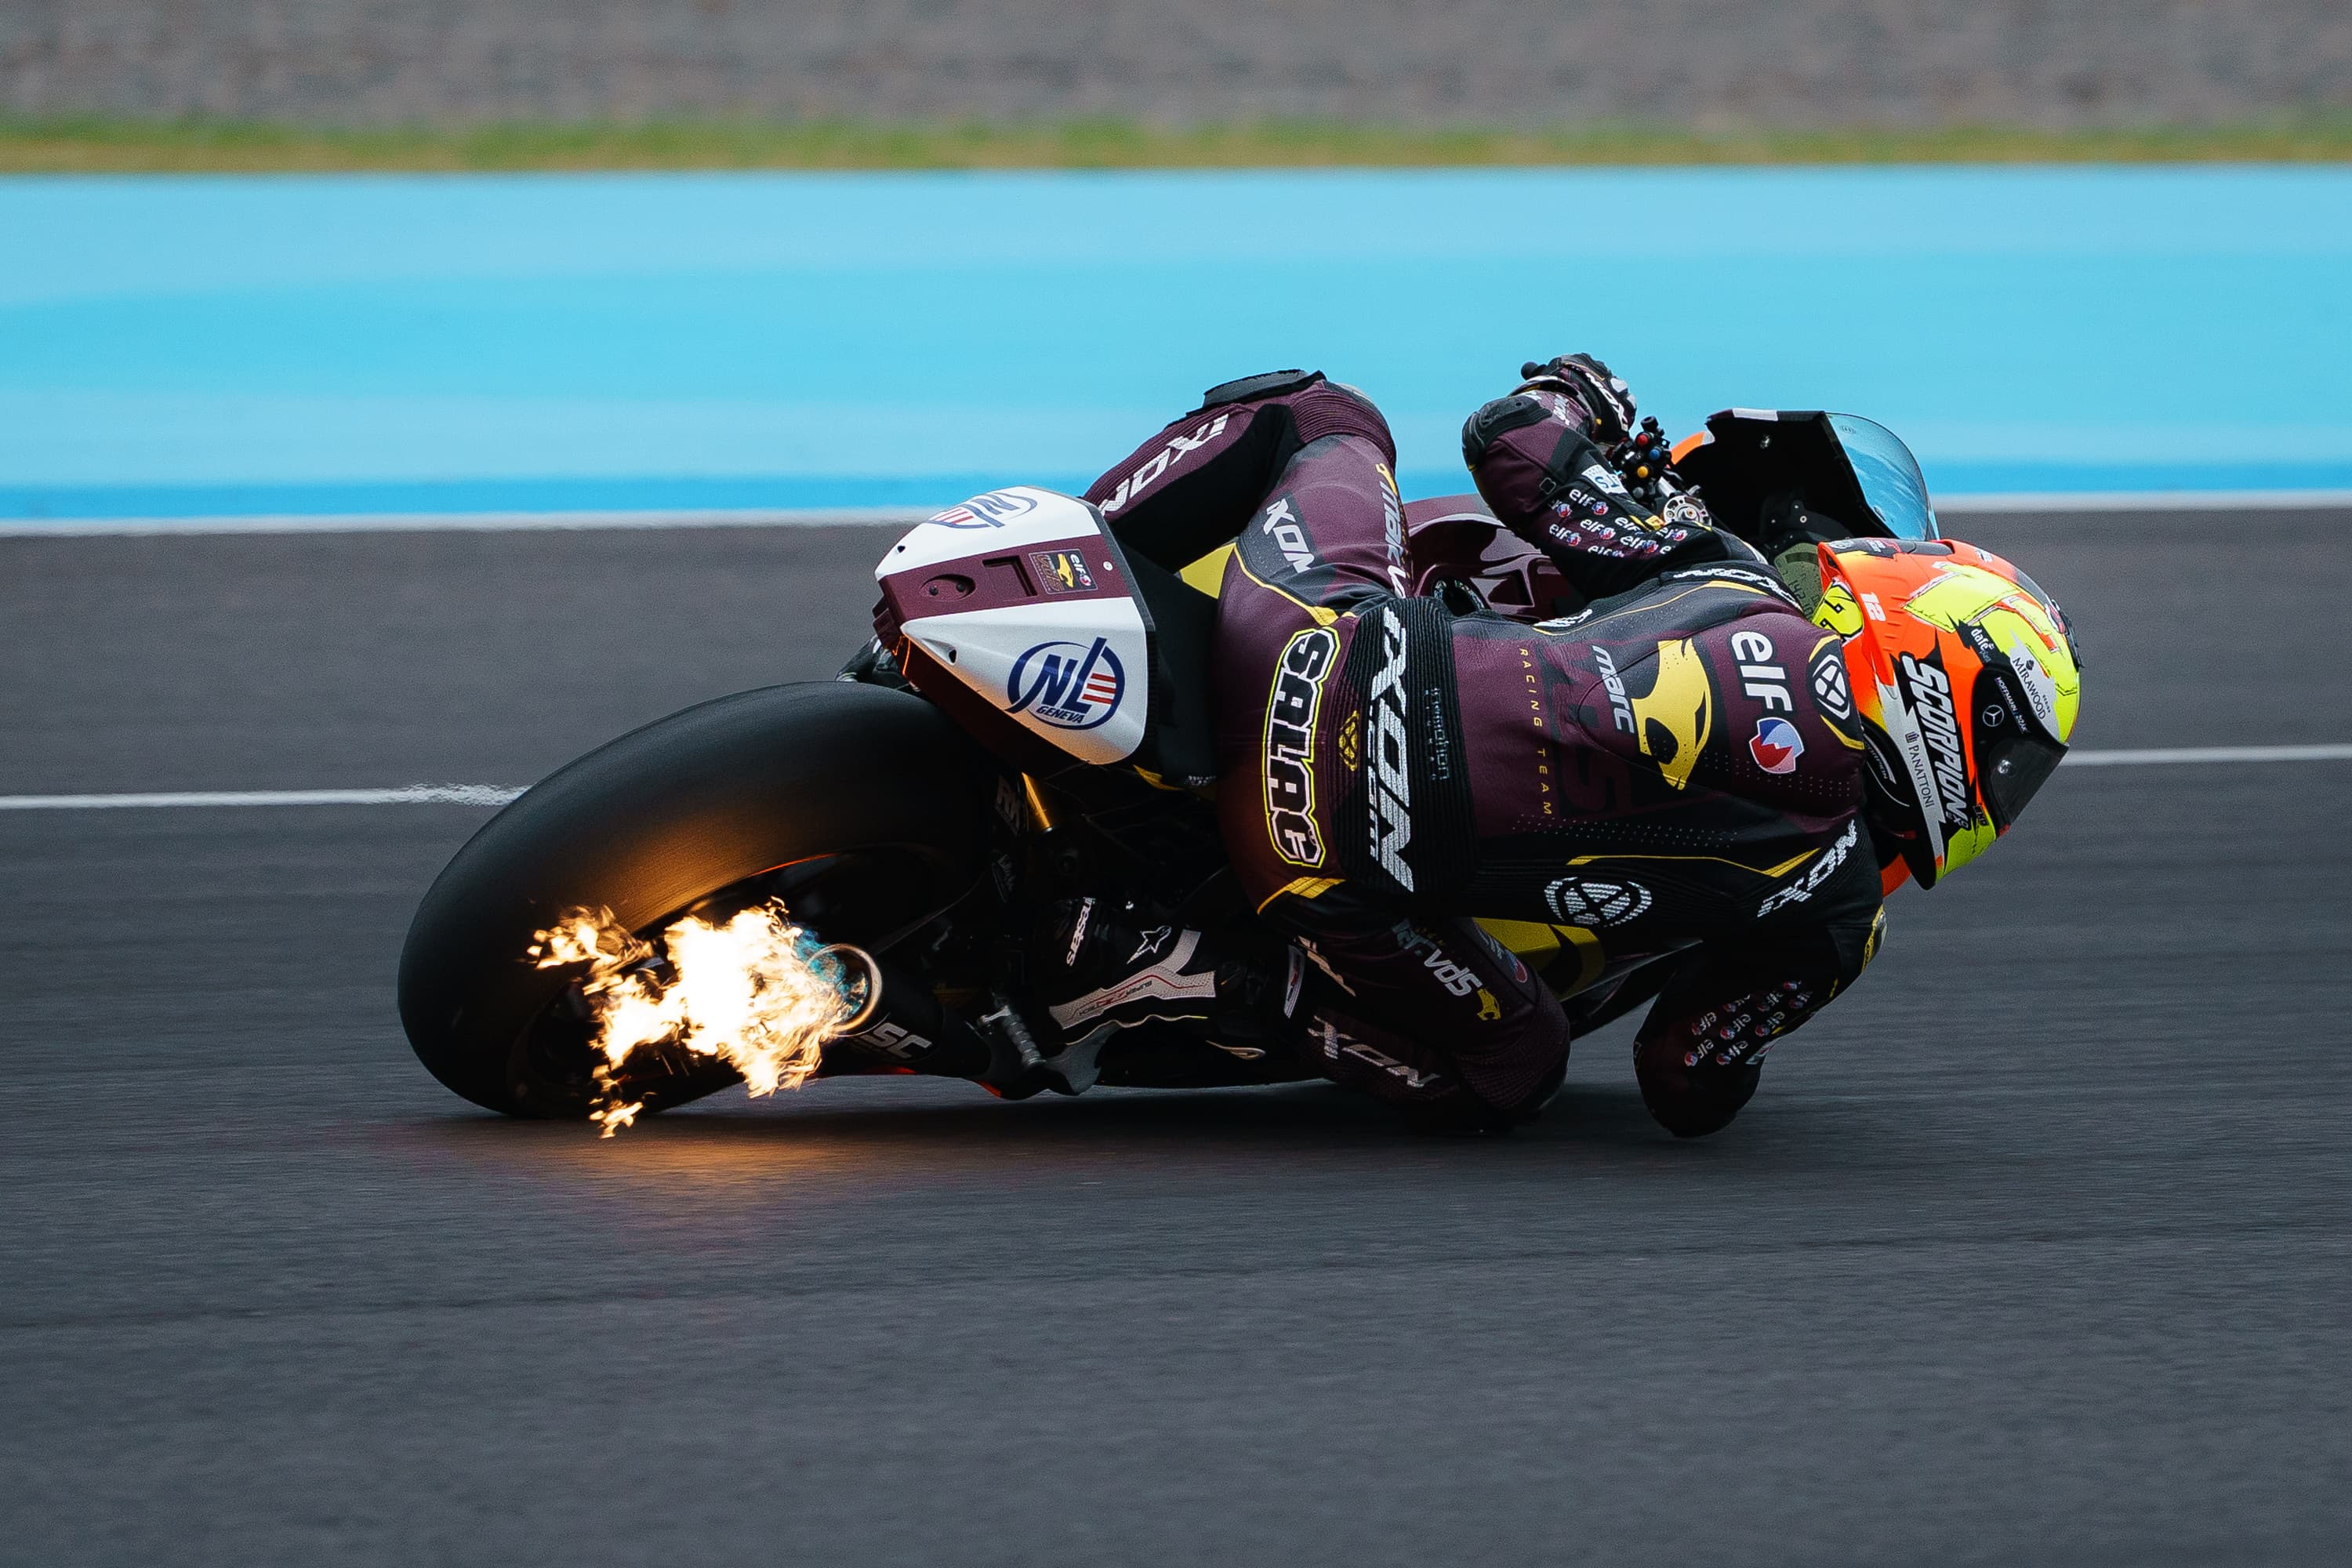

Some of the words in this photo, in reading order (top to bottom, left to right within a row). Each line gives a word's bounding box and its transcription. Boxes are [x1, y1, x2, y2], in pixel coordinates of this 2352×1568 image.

[1099, 413, 1229, 516] IXON
[1569, 488, 1596, 507] elf
[1549, 523, 1570, 542] elf
[1580, 518, 1605, 533] elf
[1620, 535, 1645, 550] elf
[1069, 553, 1087, 575] elf
[1860, 592, 1886, 622] 12
[1970, 628, 1991, 652] dafe
[1731, 630, 1793, 713] elf
[1591, 644, 1635, 734] marc
[2013, 657, 2046, 720] MIRAWOOD
[1036, 704, 1087, 724] GENEVA
[1519, 648, 1544, 728] RACING
[1537, 747, 1553, 815] TEAM
[1903, 655, 1970, 821] SCORPION
[1369, 606, 1414, 892] IXON
[1911, 744, 1935, 808] PANATTONI
[1699, 1011, 1718, 1032] elf
[1732, 1013, 1752, 1033] elf
[1766, 1011, 1786, 1029] elf
[1697, 1038, 1715, 1058] elf
[1727, 1040, 1749, 1058] elf
